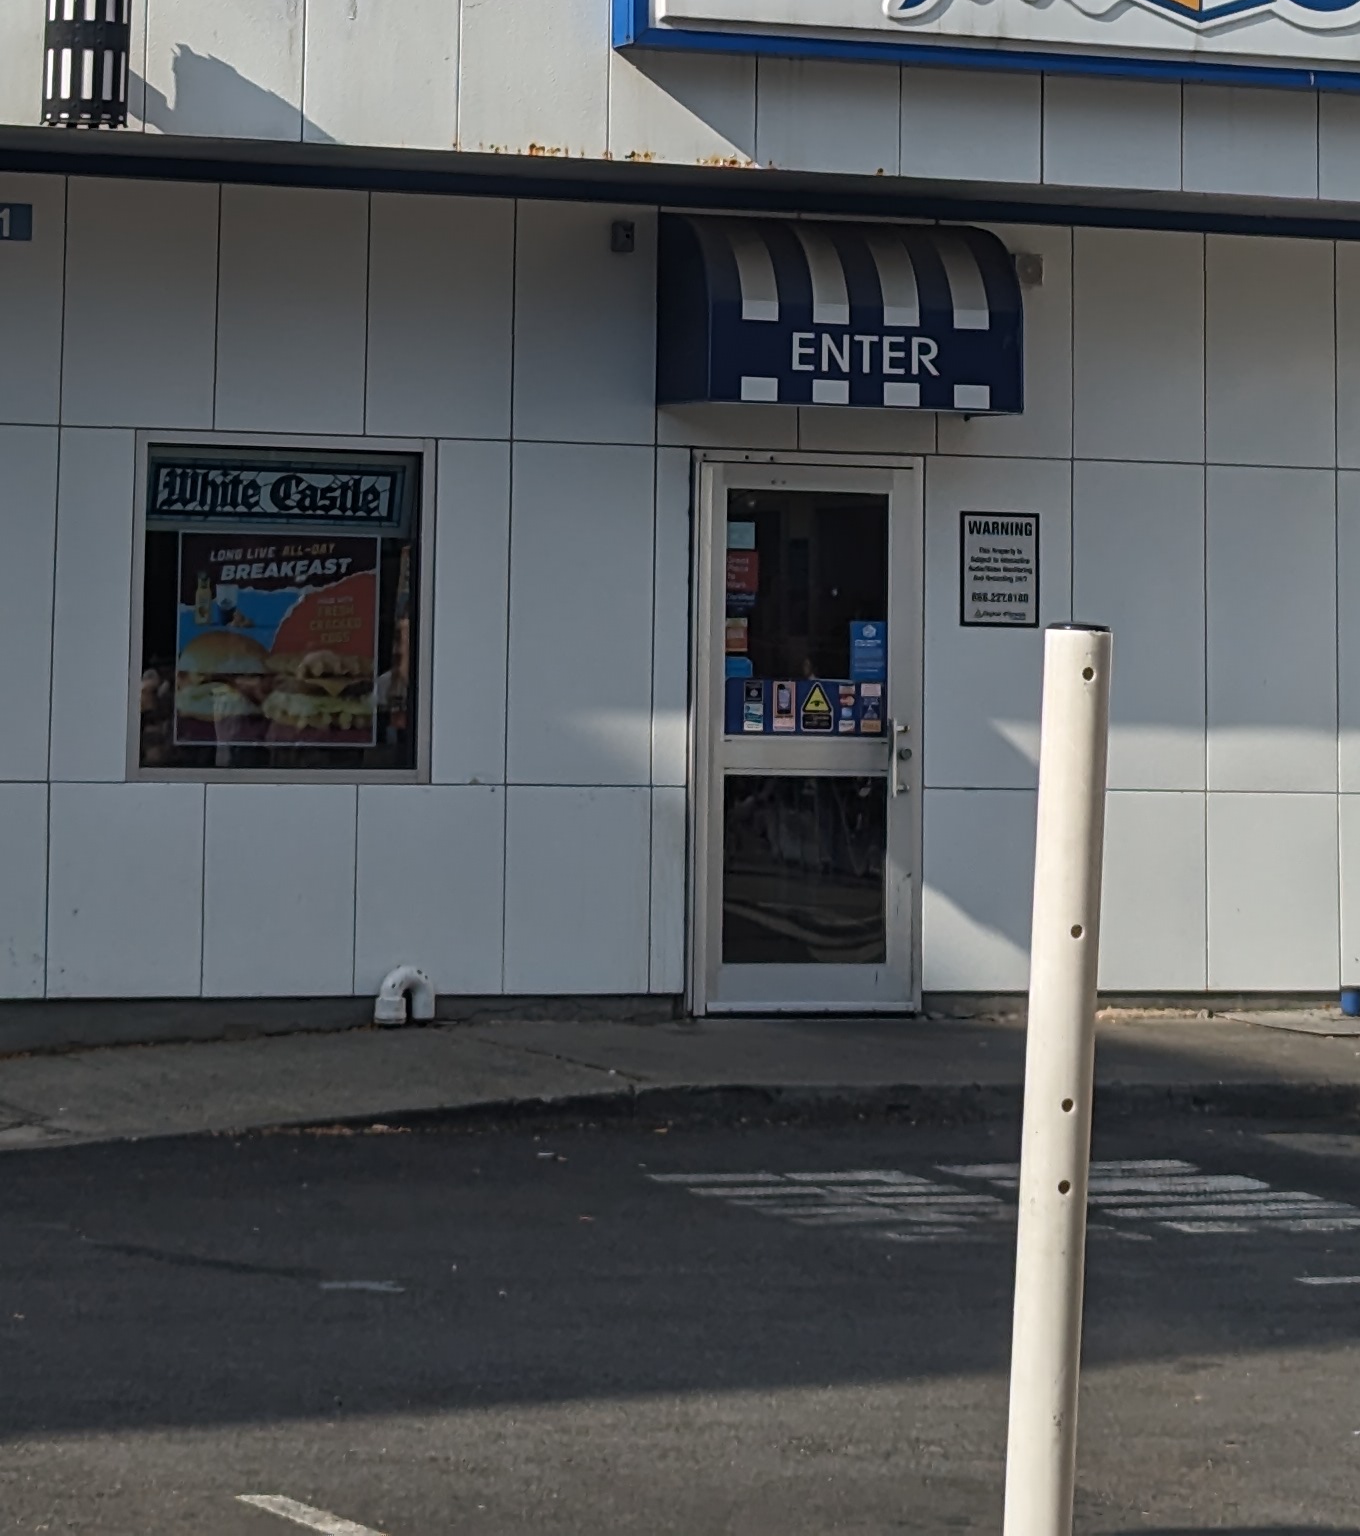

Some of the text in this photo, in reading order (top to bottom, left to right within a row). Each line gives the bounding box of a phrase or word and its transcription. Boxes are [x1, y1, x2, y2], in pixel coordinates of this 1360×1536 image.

[792, 331, 940, 376] ENTER
[161, 467, 380, 515] White Castle
[968, 520, 1033, 537] WARNING
[210, 543, 336, 562] LONG LIVE ALL-DAY
[221, 557, 353, 582] BREAKFAST
